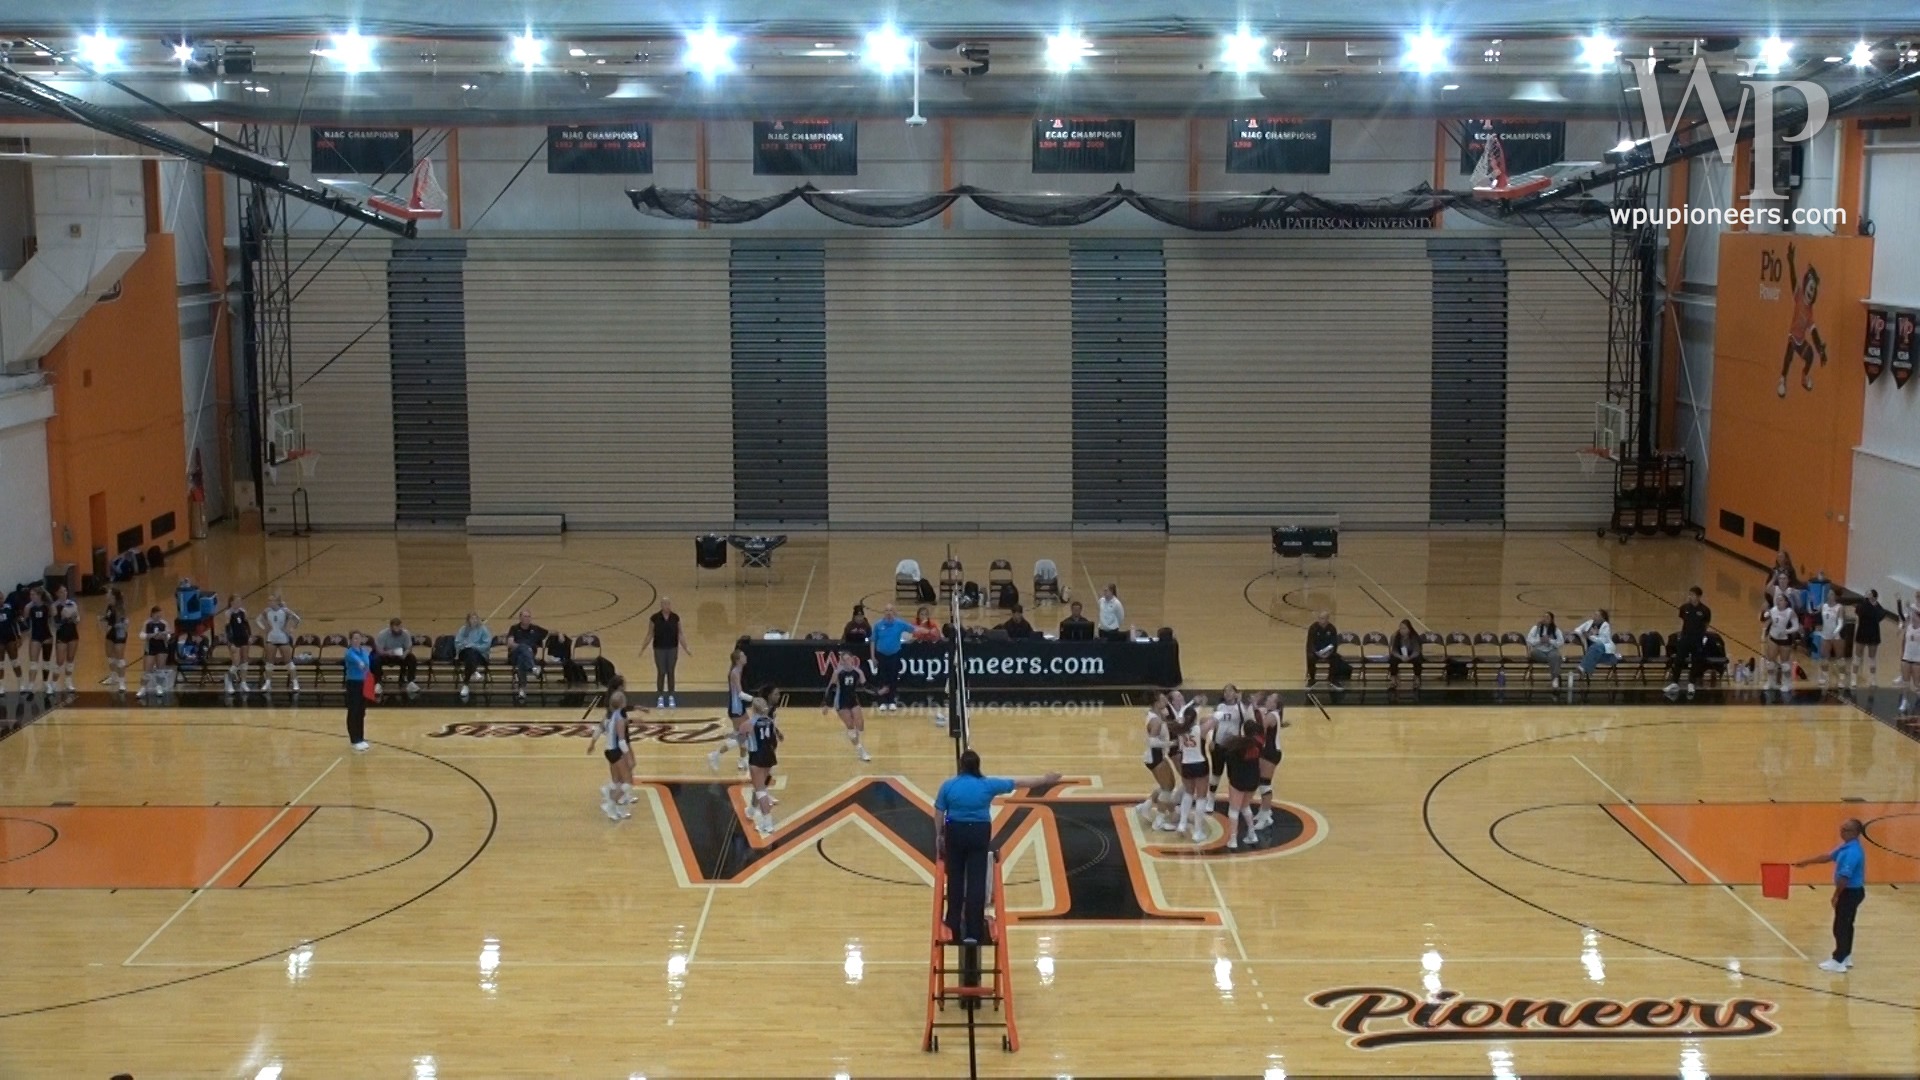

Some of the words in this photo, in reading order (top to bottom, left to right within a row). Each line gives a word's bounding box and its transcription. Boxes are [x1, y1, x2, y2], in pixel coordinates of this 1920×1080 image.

[348, 131, 399, 139] CHAMPIONS
[562, 131, 584, 140] NJAC
[586, 131, 639, 140] CHAMPIONS
[791, 133, 844, 141] CHAMPIONS
[1070, 131, 1122, 139] CHAMPIONS
[1241, 131, 1262, 139] NJAC
[1265, 131, 1317, 140] CHAMPIONS
[1286, 216, 1352, 229] PATERSON
[1355, 216, 1434, 229] UNIVERSITY
[1760, 249, 1782, 282] Pio
[867, 651, 1104, 680] upineers.com
[760, 727, 770, 740] 14
[1303, 985, 1781, 1050] Pioneers
